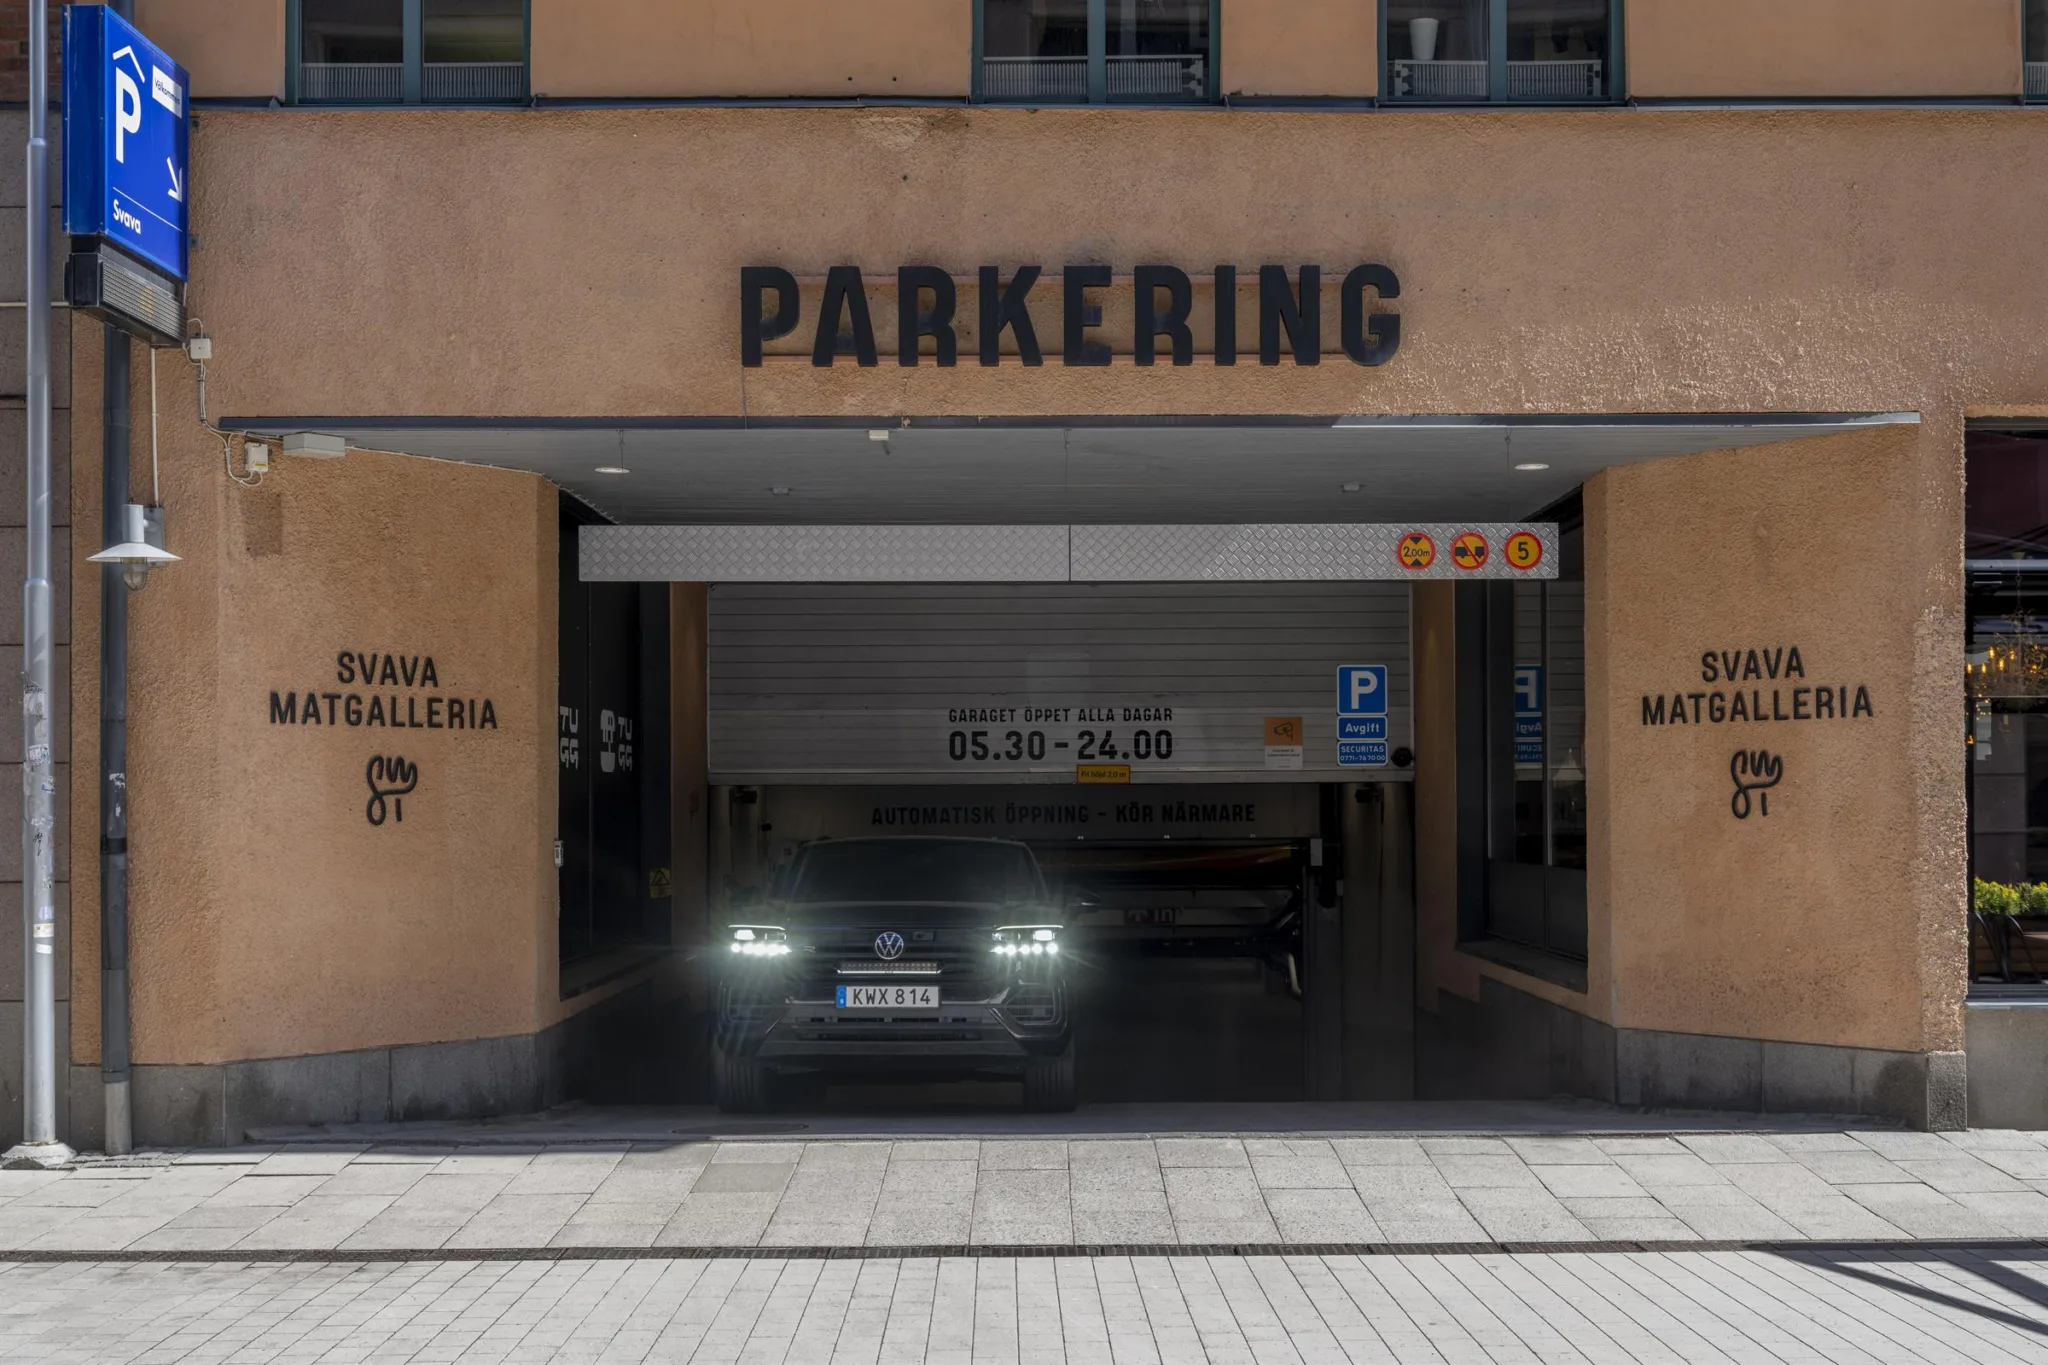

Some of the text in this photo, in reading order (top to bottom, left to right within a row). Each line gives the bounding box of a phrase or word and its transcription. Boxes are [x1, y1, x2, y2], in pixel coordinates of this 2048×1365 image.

[116, 67, 141, 163] P
[113, 199, 141, 234] Svava
[741, 264, 1400, 367] PARKERING
[1517, 541, 1529, 560] 5
[337, 651, 439, 688] SVAVA
[1702, 646, 1805, 683] SVAVA
[1350, 670, 1378, 710] P
[1642, 685, 1874, 726] MATGALLERIA
[269, 691, 498, 730] MATGALLERIA
[949, 705, 1173, 723] GARAGET ÖPPET ALLA DAGAR
[949, 730, 1046, 761] 05.30
[1077, 730, 1173, 760] 24.00
[1345, 722, 1380, 736] Avgift
[1341, 745, 1384, 753] SECURITAS
[1081, 770, 1089, 778] Fri
[871, 806, 994, 826] AUTOMATISK
[1005, 803, 1089, 824] ÖPPNING
[1115, 802, 1153, 823] KÖR
[1162, 801, 1255, 823] NÄRMARE
[853, 988, 888, 1005] KWX
[895, 988, 931, 1005] 814
